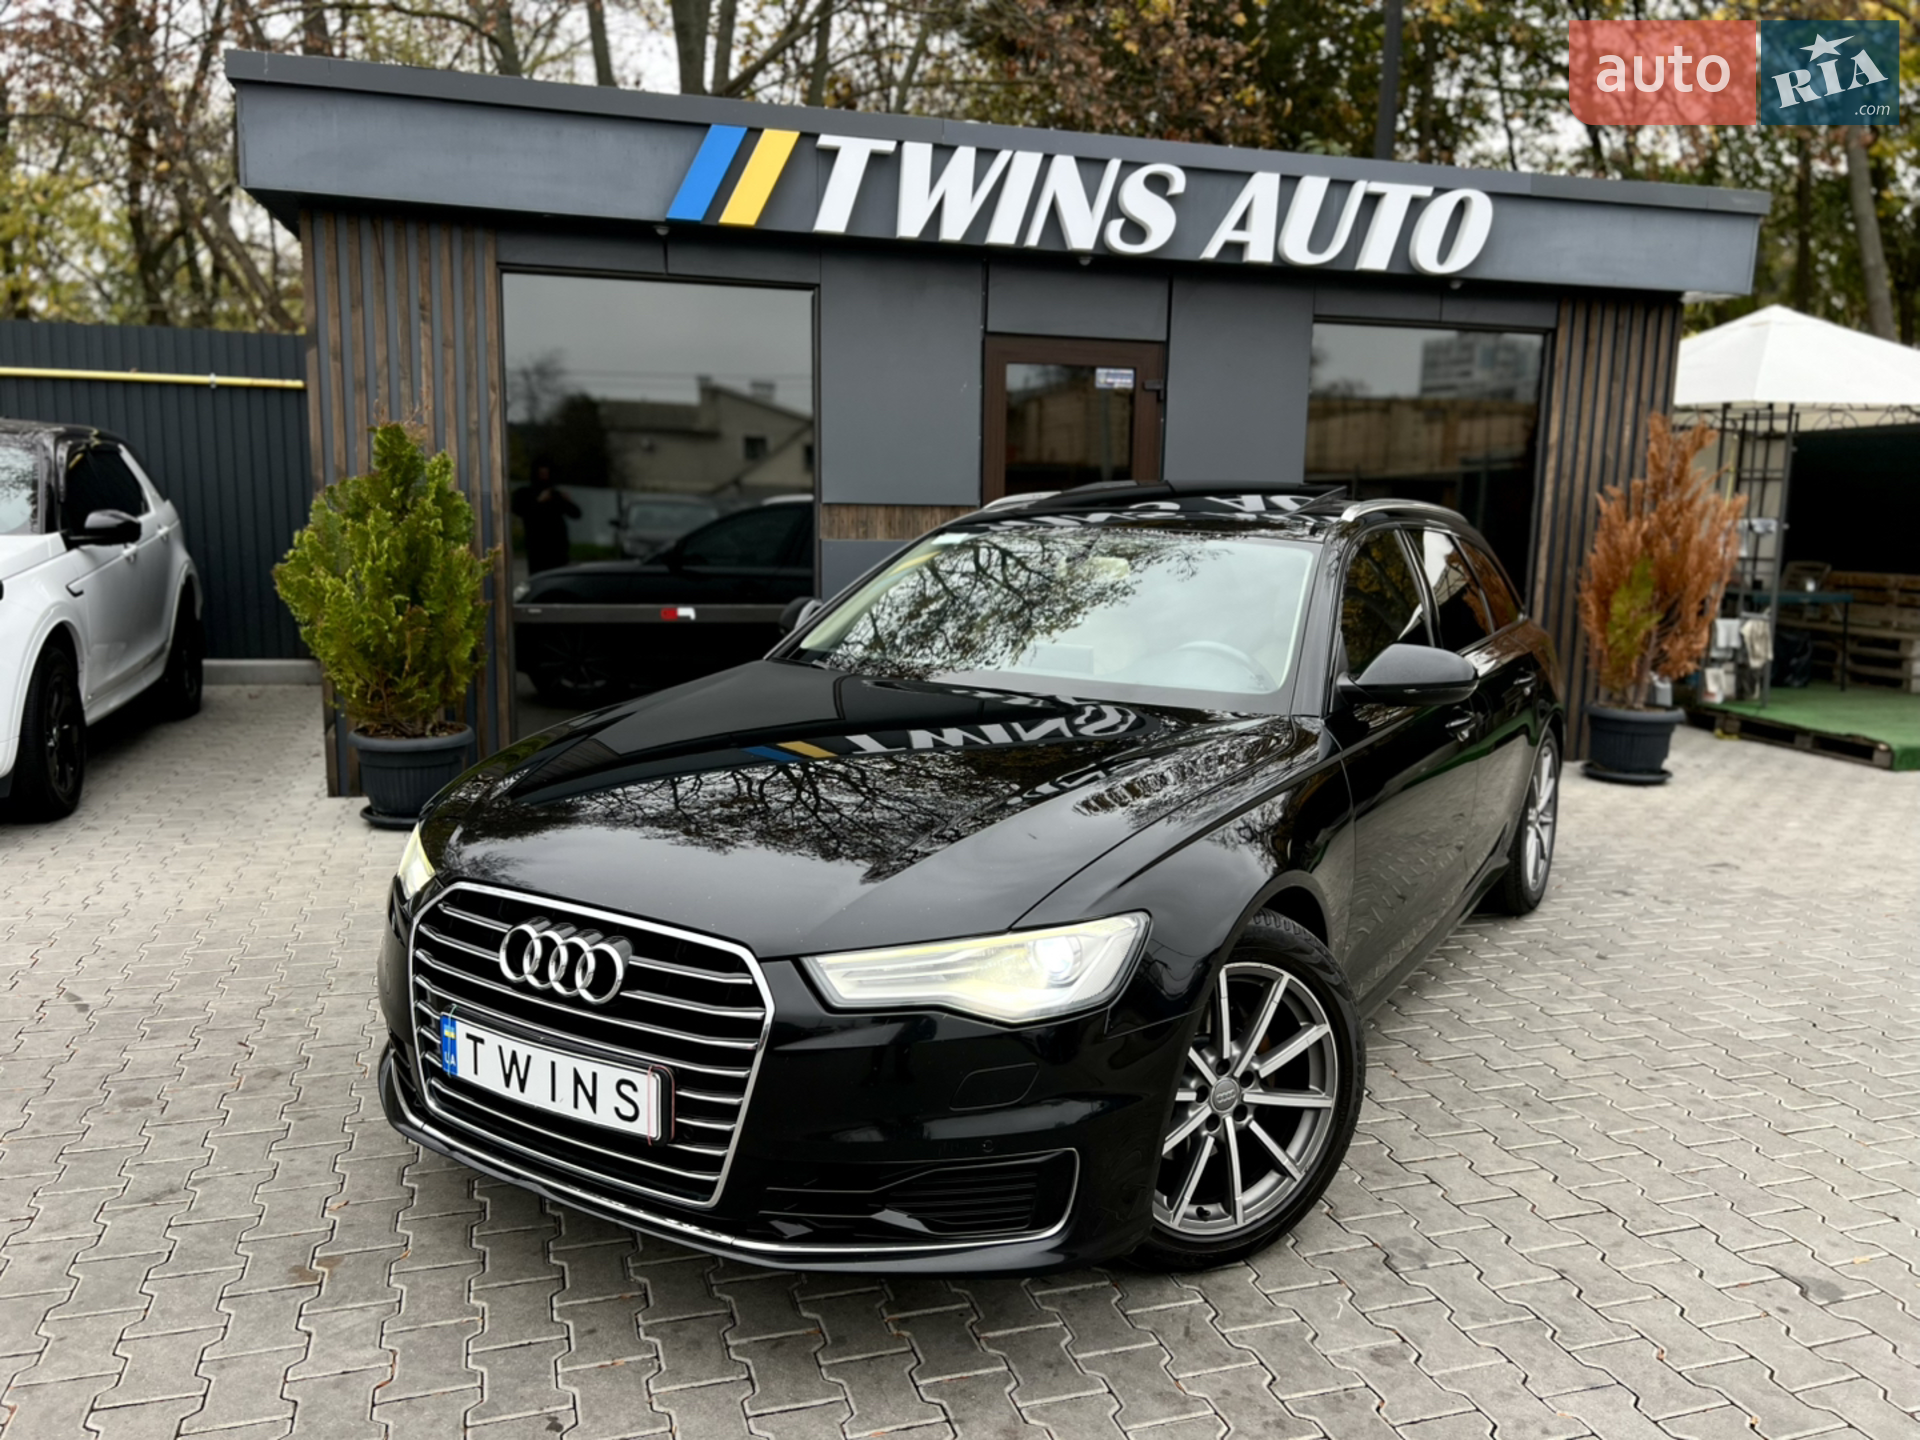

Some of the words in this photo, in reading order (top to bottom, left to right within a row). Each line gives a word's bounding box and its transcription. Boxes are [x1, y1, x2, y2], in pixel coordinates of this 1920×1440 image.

[812, 133, 1187, 256] TWINS
[1200, 171, 1494, 275] AUTO
[444, 1051, 457, 1067] UA
[466, 1032, 640, 1123] TWINS
